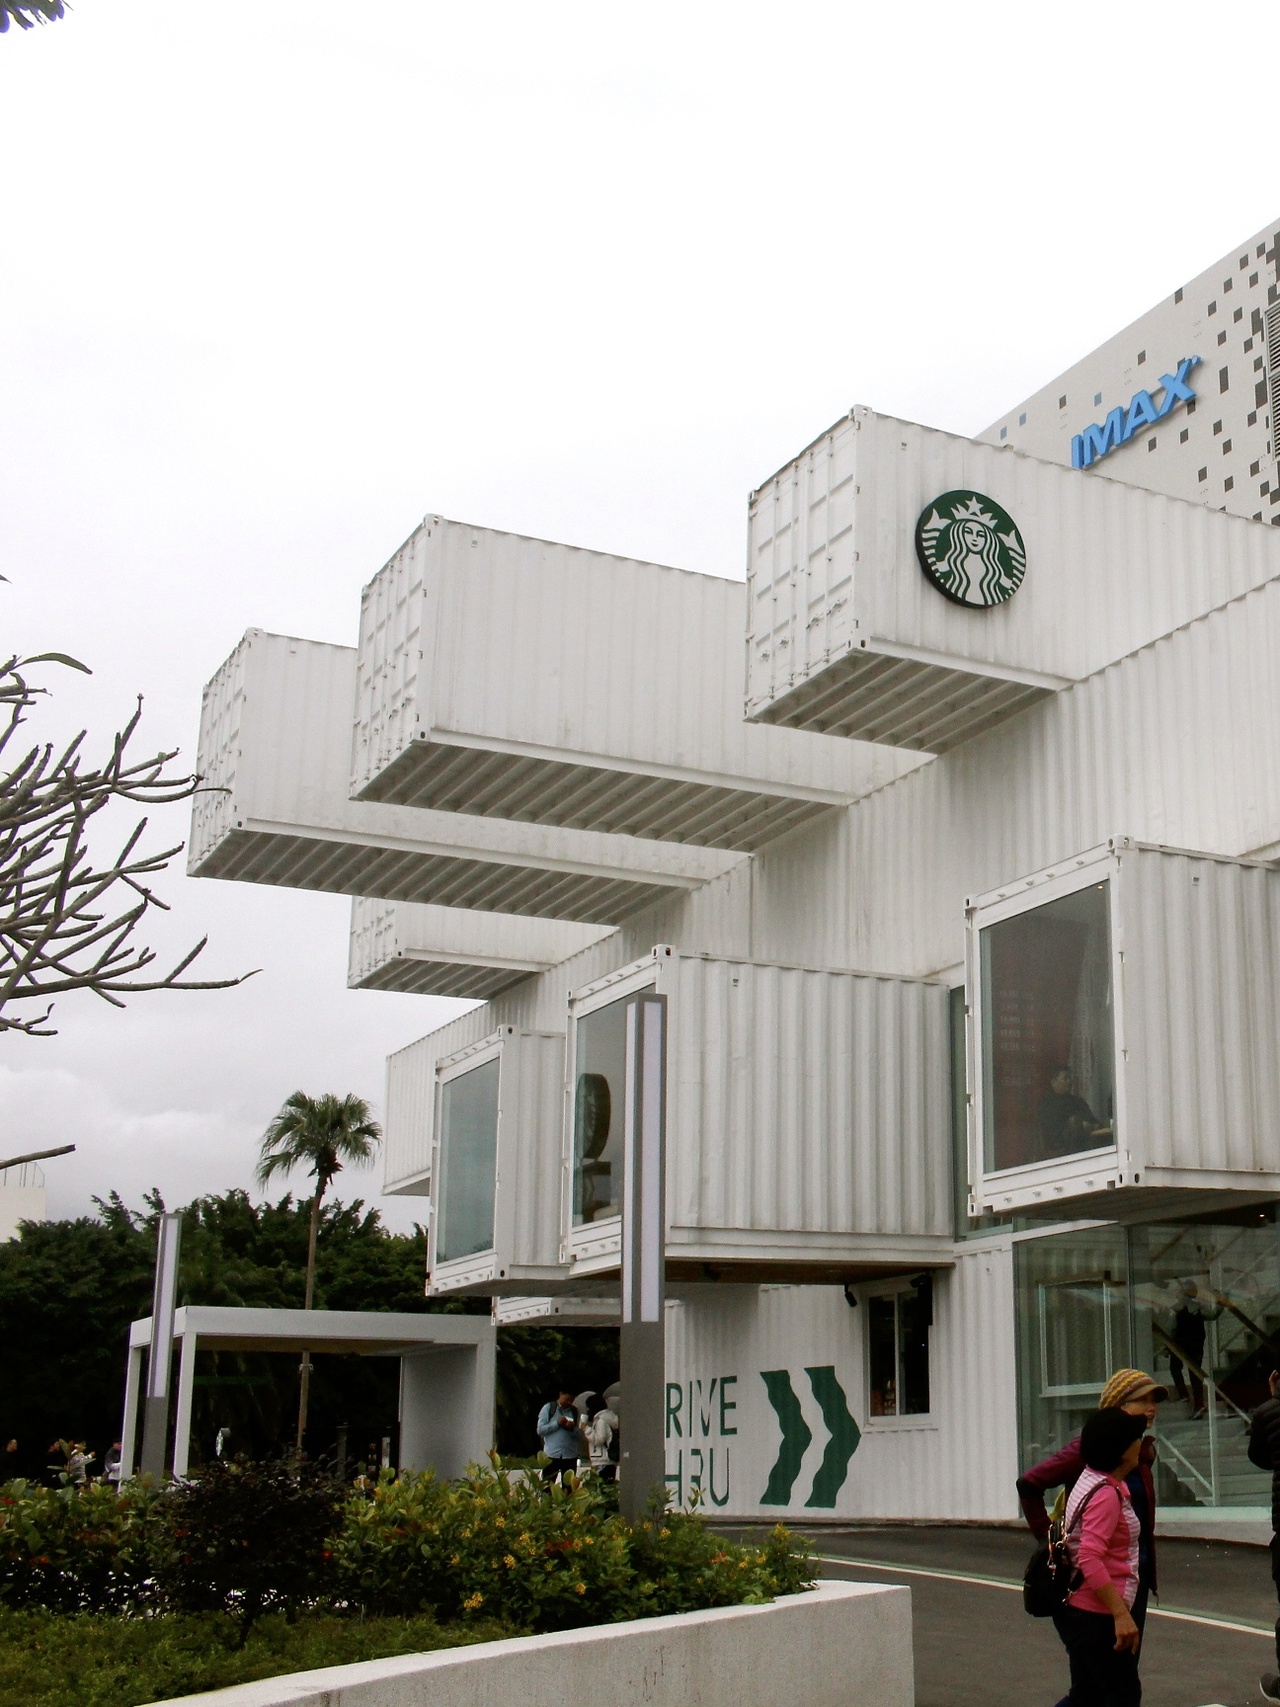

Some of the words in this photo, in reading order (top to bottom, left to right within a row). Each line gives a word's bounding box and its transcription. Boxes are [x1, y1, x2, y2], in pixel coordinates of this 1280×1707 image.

[1071, 357, 1199, 470] IMAX
[666, 1375, 737, 1439] RIVE
[664, 1447, 730, 1507] HRU
